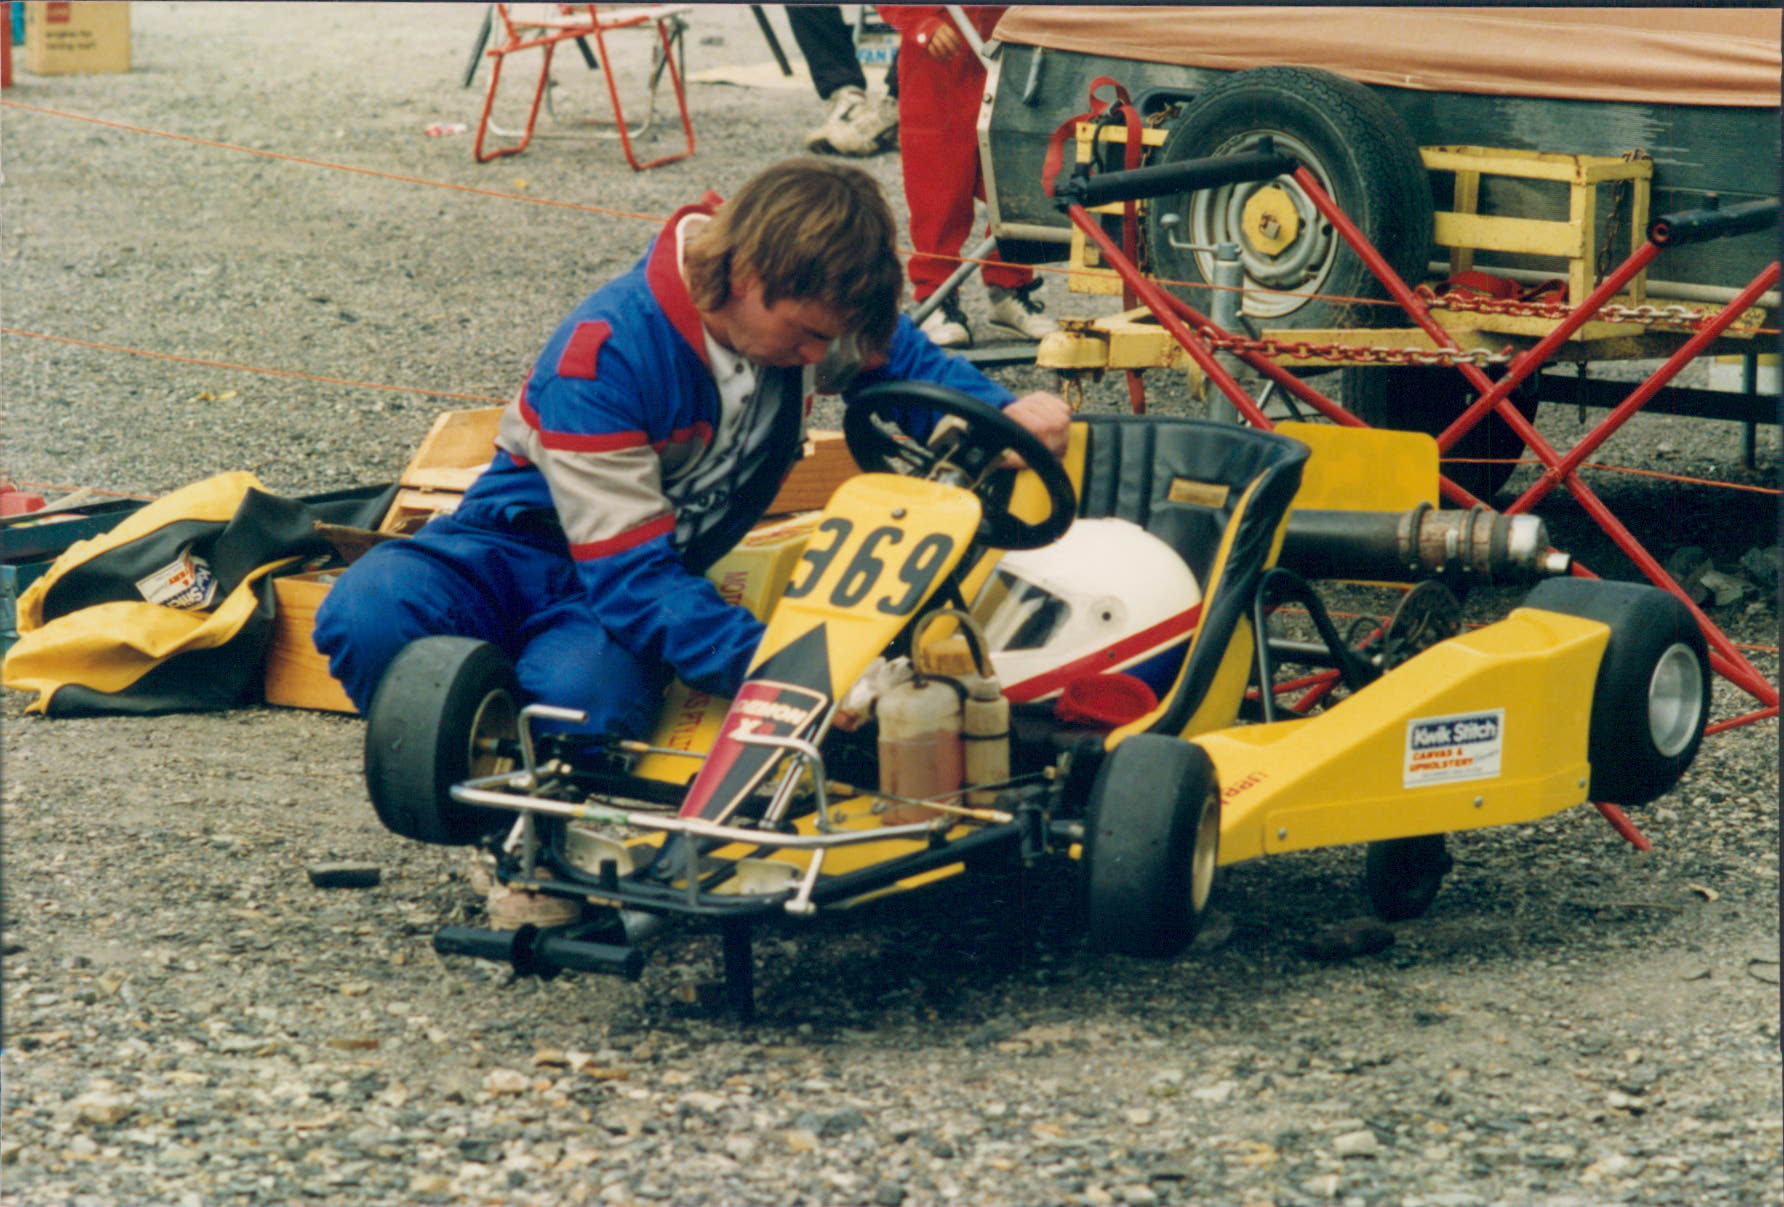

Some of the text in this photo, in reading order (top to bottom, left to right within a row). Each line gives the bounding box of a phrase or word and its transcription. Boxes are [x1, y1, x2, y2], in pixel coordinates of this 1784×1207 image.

[783, 517, 954, 616] 369
[1413, 718, 1497, 747] Kwik Stitch
[1408, 757, 1473, 772] UPHOLSTERY
[1412, 749, 1453, 761] CANVAS
[1456, 746, 1463, 756] &
